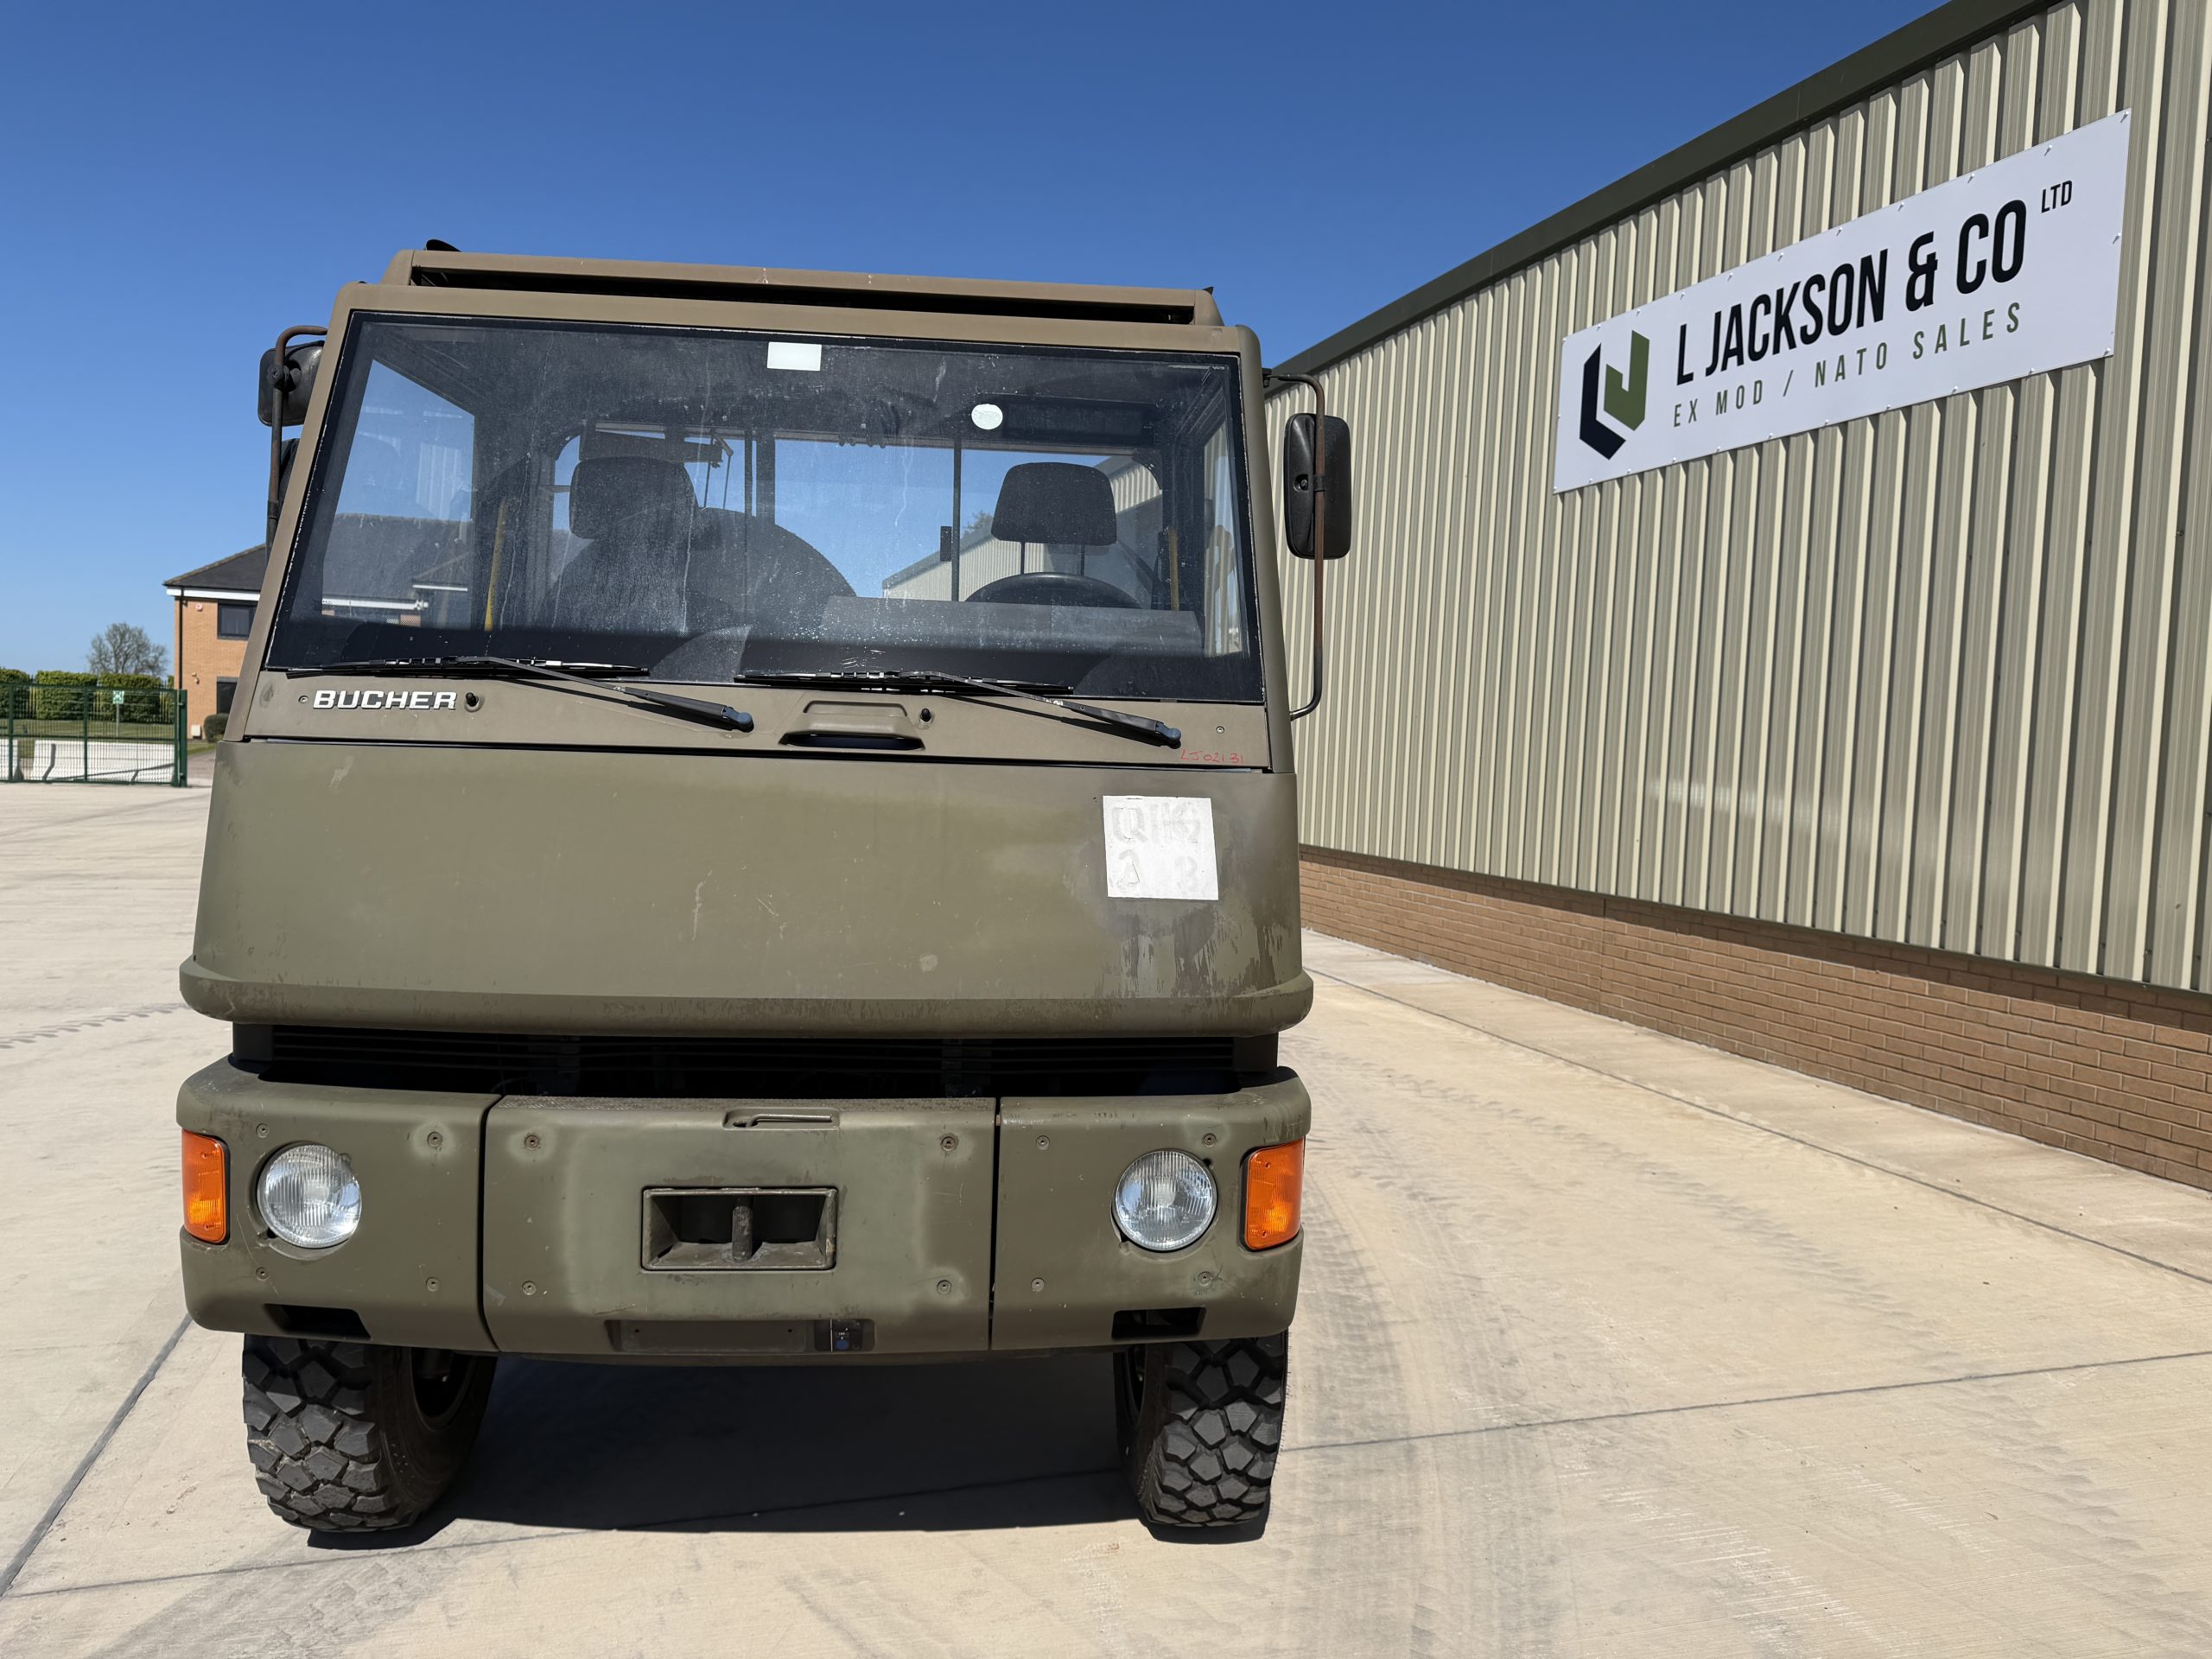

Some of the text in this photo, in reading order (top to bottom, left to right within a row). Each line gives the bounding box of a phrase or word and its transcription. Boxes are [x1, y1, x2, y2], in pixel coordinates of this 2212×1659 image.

[1676, 180, 2073, 386] L JACKSON & CO LTD
[1673, 302, 2021, 428] EX MOD / NATO SALES
[312, 690, 458, 710] BUCHER
